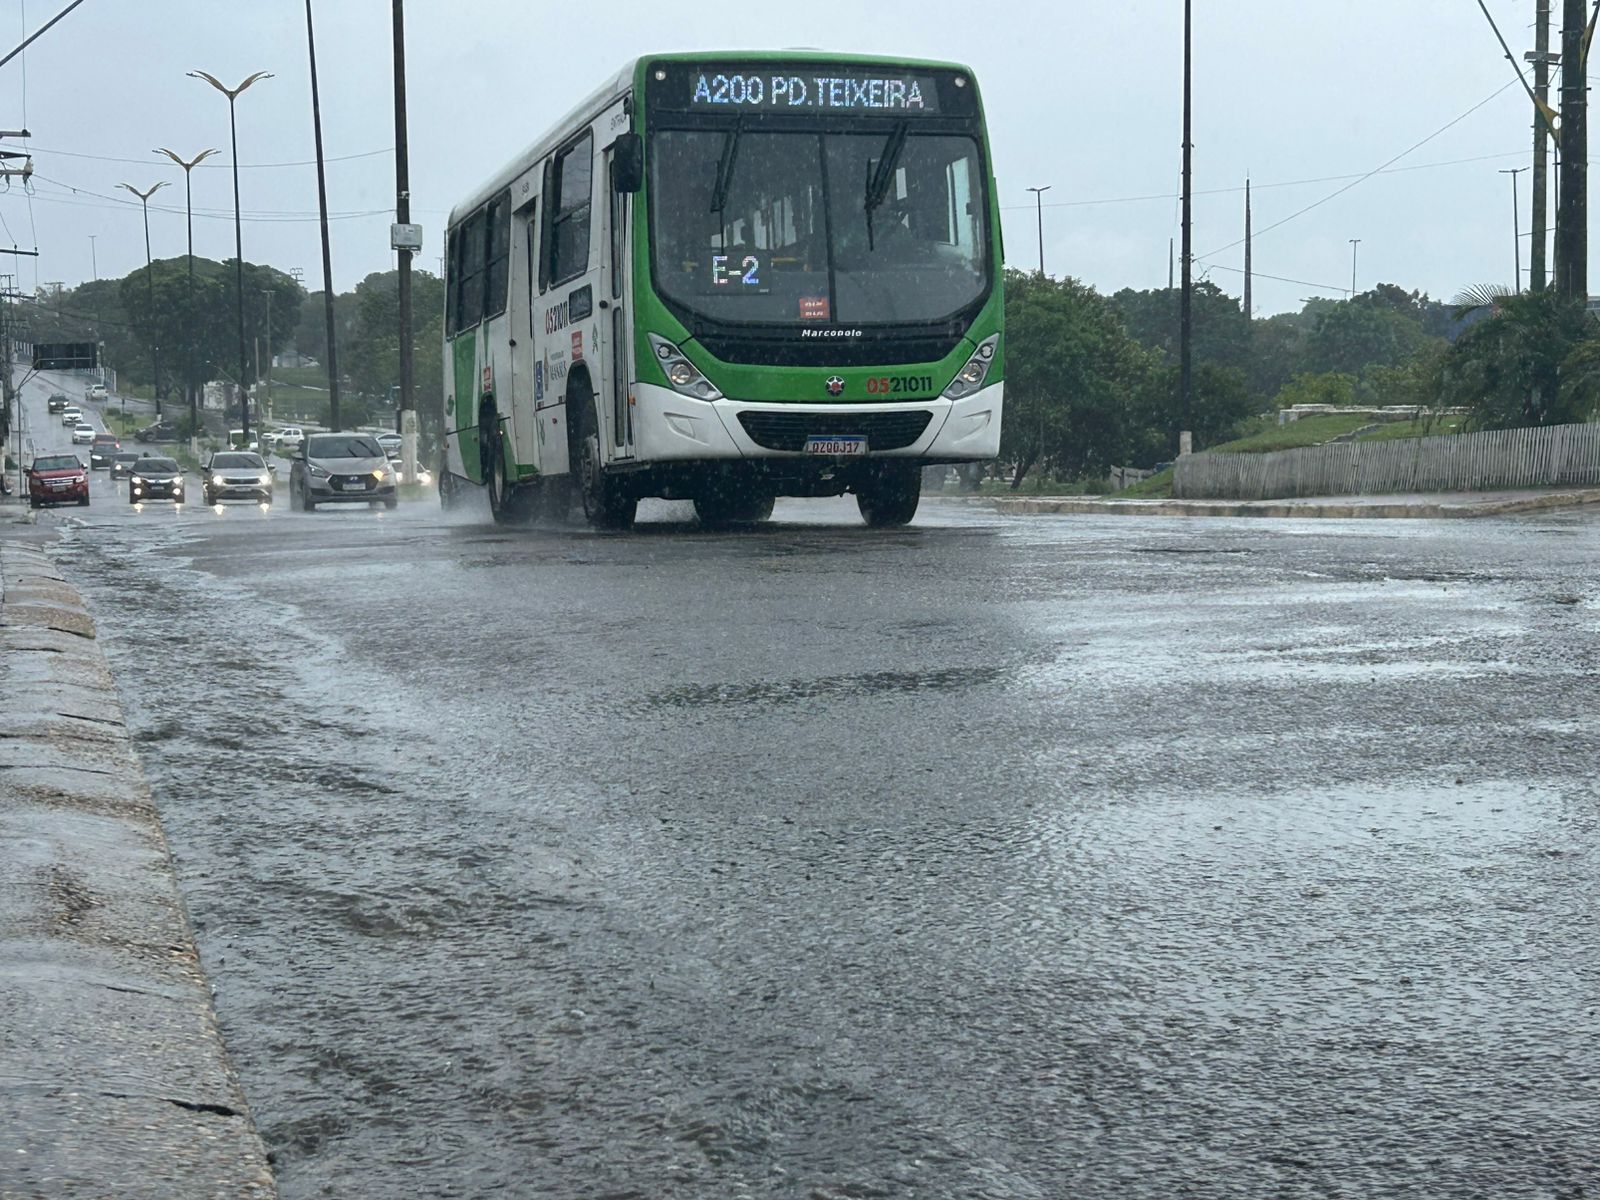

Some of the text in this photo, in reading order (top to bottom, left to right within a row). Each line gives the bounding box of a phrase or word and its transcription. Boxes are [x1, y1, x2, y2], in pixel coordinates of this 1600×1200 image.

[693, 73, 925, 109] A200 PD.TEIXEIRA
[712, 255, 760, 285] E-2
[801, 328, 863, 338] Marcopolo
[866, 376, 933, 394] 0521011
